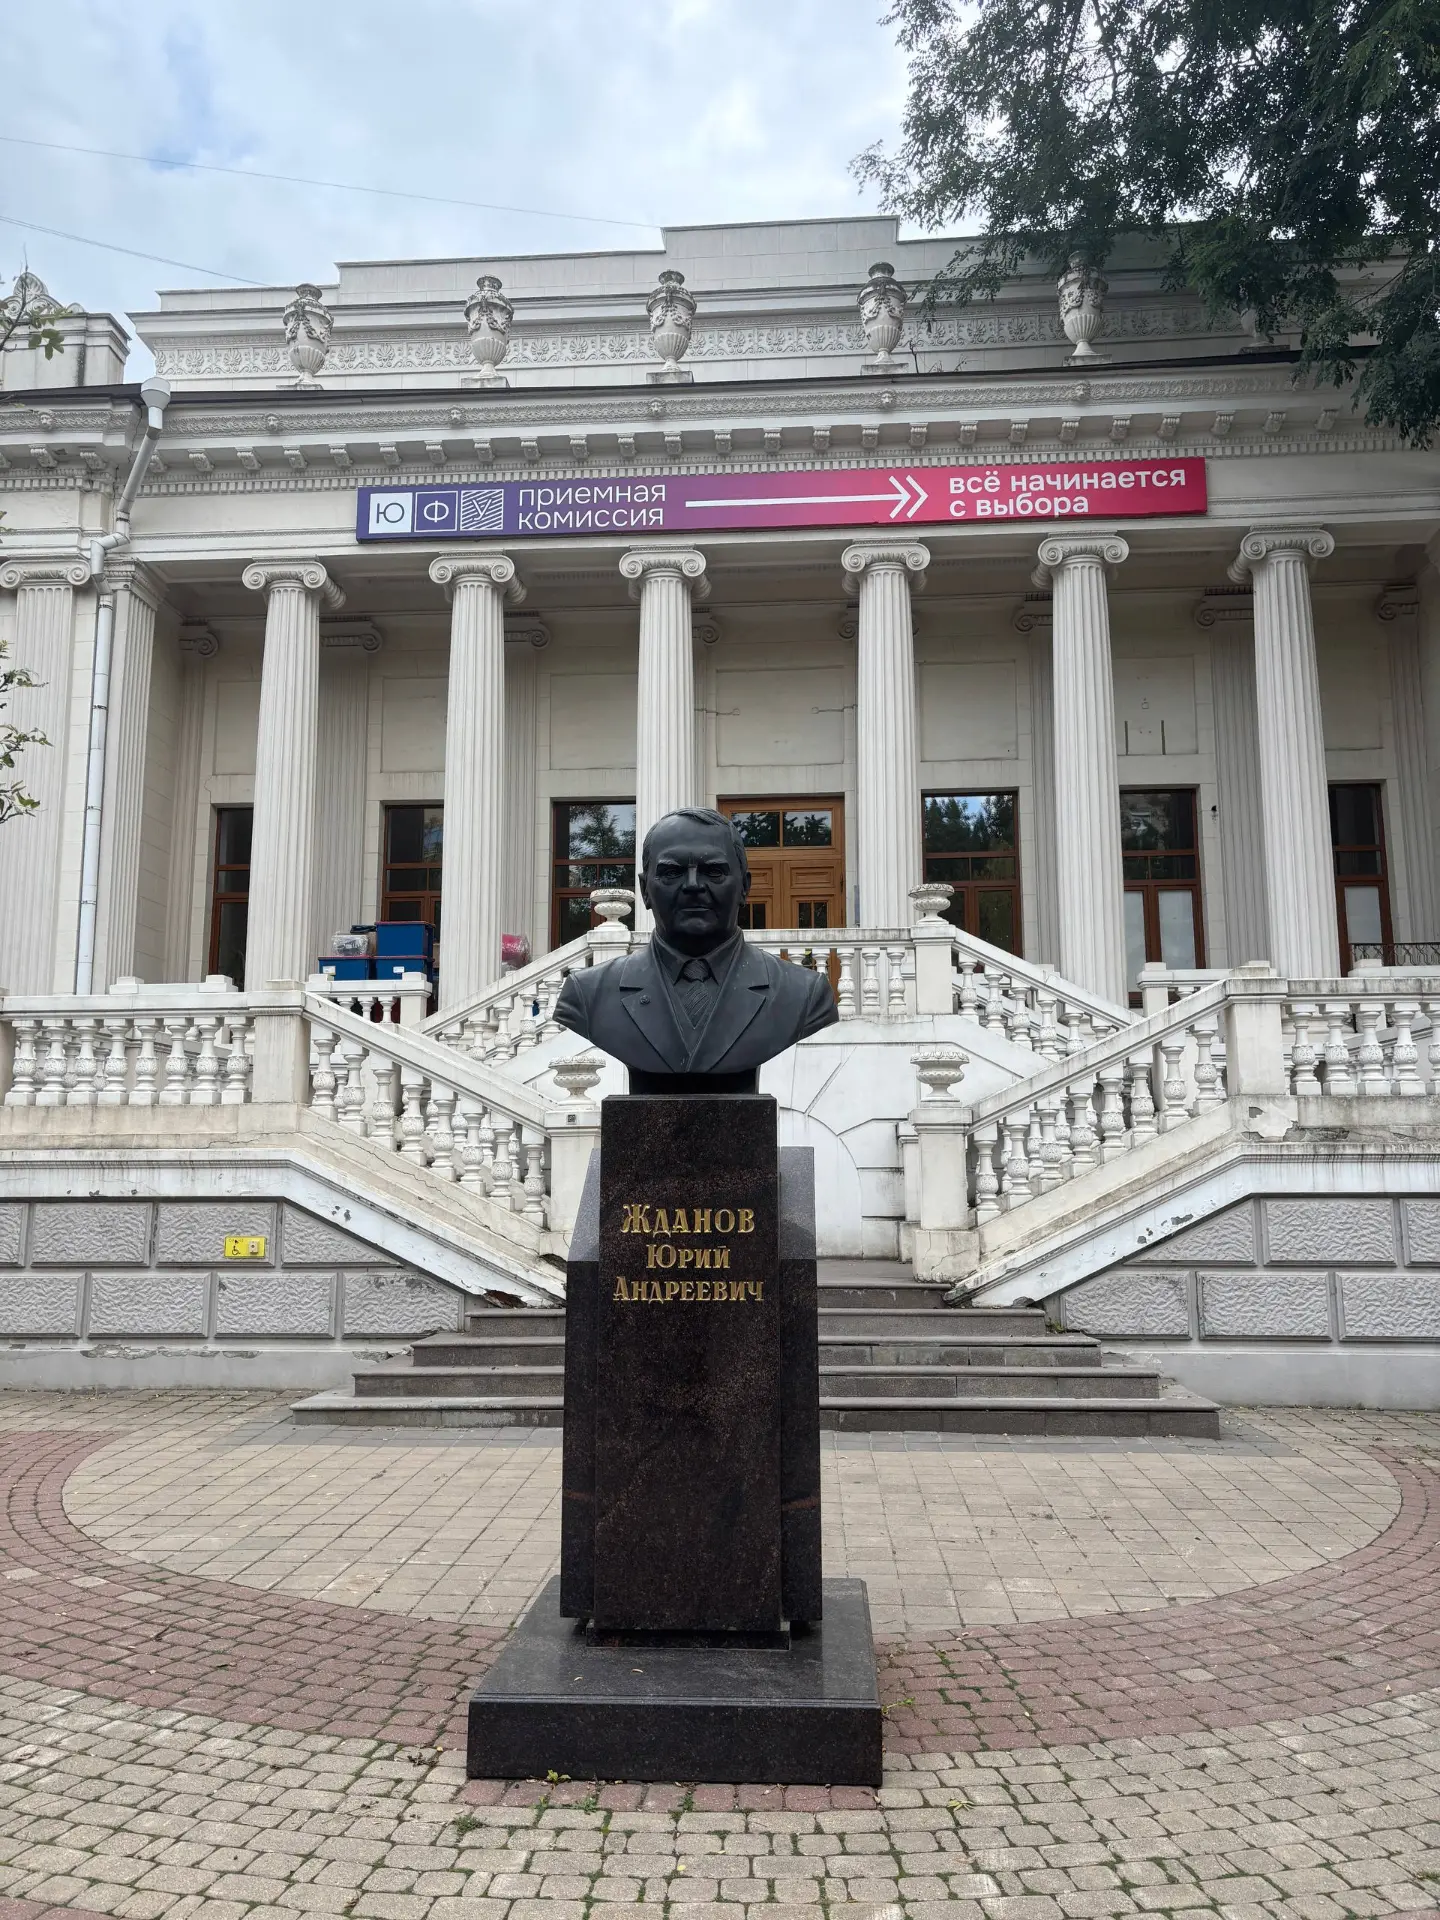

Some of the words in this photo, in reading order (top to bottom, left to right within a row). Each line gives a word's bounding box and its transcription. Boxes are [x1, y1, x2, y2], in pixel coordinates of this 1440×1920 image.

[949, 471, 1000, 494] всё
[1011, 468, 1186, 492] начинается
[518, 484, 667, 508] приемная
[949, 499, 966, 517] с
[976, 492, 1089, 517] выбора
[518, 508, 665, 530] комиссия
[620, 1204, 755, 1238] ЖДАНОВ
[645, 1244, 731, 1269] ЮРИЙ
[612, 1276, 764, 1304] АНДРЕЕВИЧ
